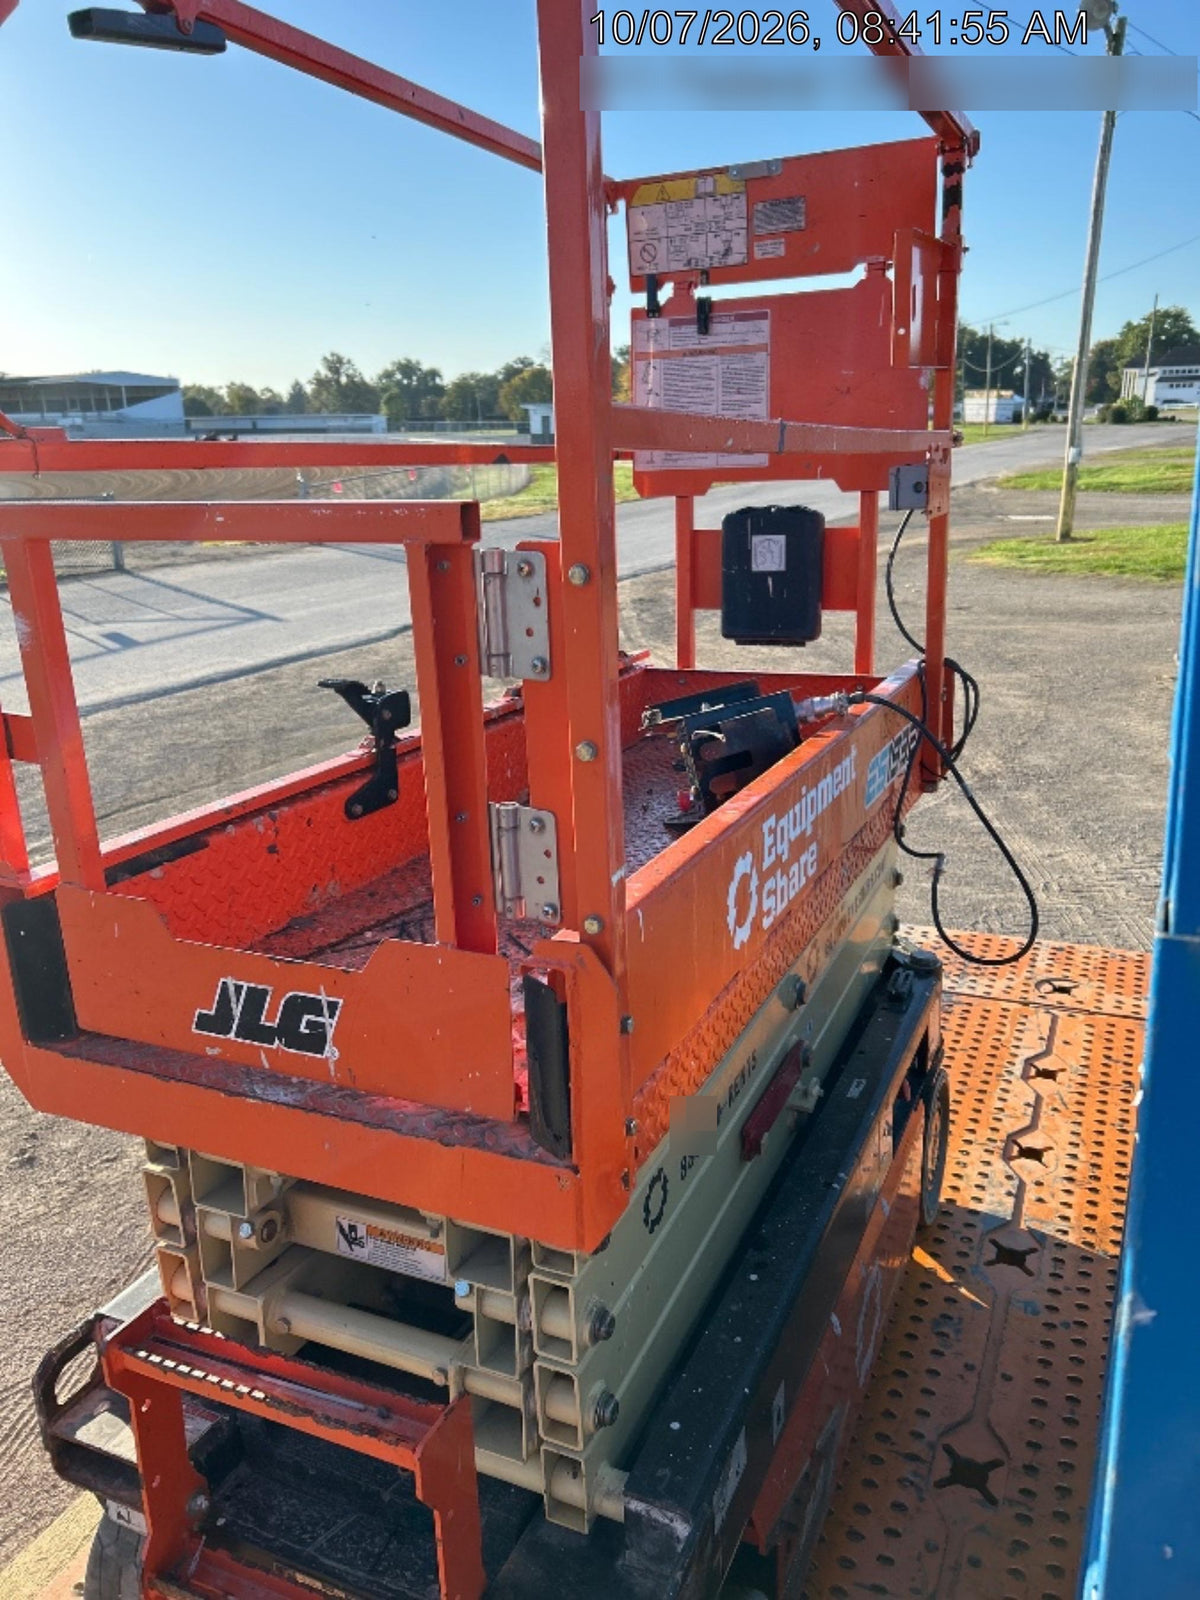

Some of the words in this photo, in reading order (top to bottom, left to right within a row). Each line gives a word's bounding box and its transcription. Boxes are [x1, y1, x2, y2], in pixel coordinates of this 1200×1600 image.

[762, 745, 857, 871] Equipment
[762, 842, 818, 930] Share
[192, 977, 343, 1058] JLG
